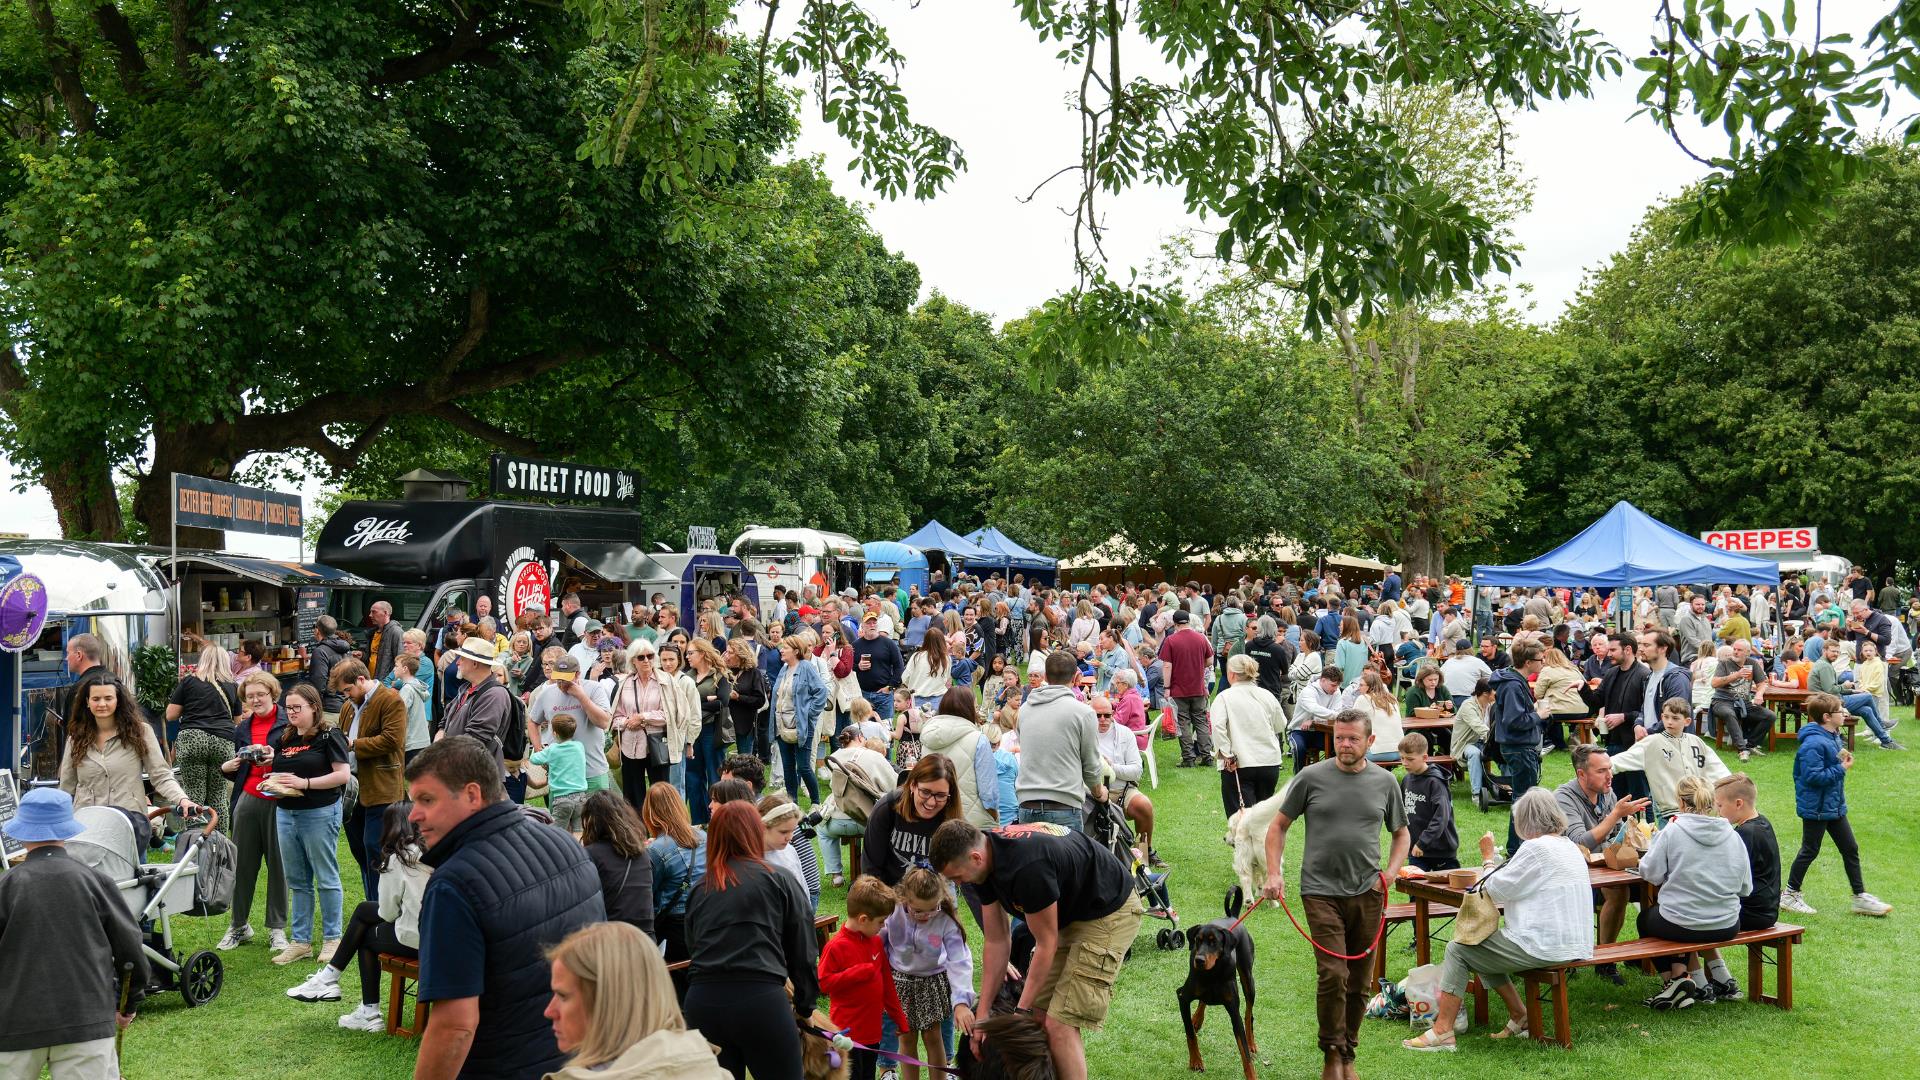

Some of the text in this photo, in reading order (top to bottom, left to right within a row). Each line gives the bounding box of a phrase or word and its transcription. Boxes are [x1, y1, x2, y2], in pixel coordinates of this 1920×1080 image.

[508, 461, 611, 497] STREET FOOD
[344, 517, 413, 549] Hatch
[1707, 529, 1812, 550] CREPES
[498, 546, 535, 624] AWARD WINNING
[519, 565, 547, 586] STREET FOOD
[890, 828, 932, 856] NIRVA
